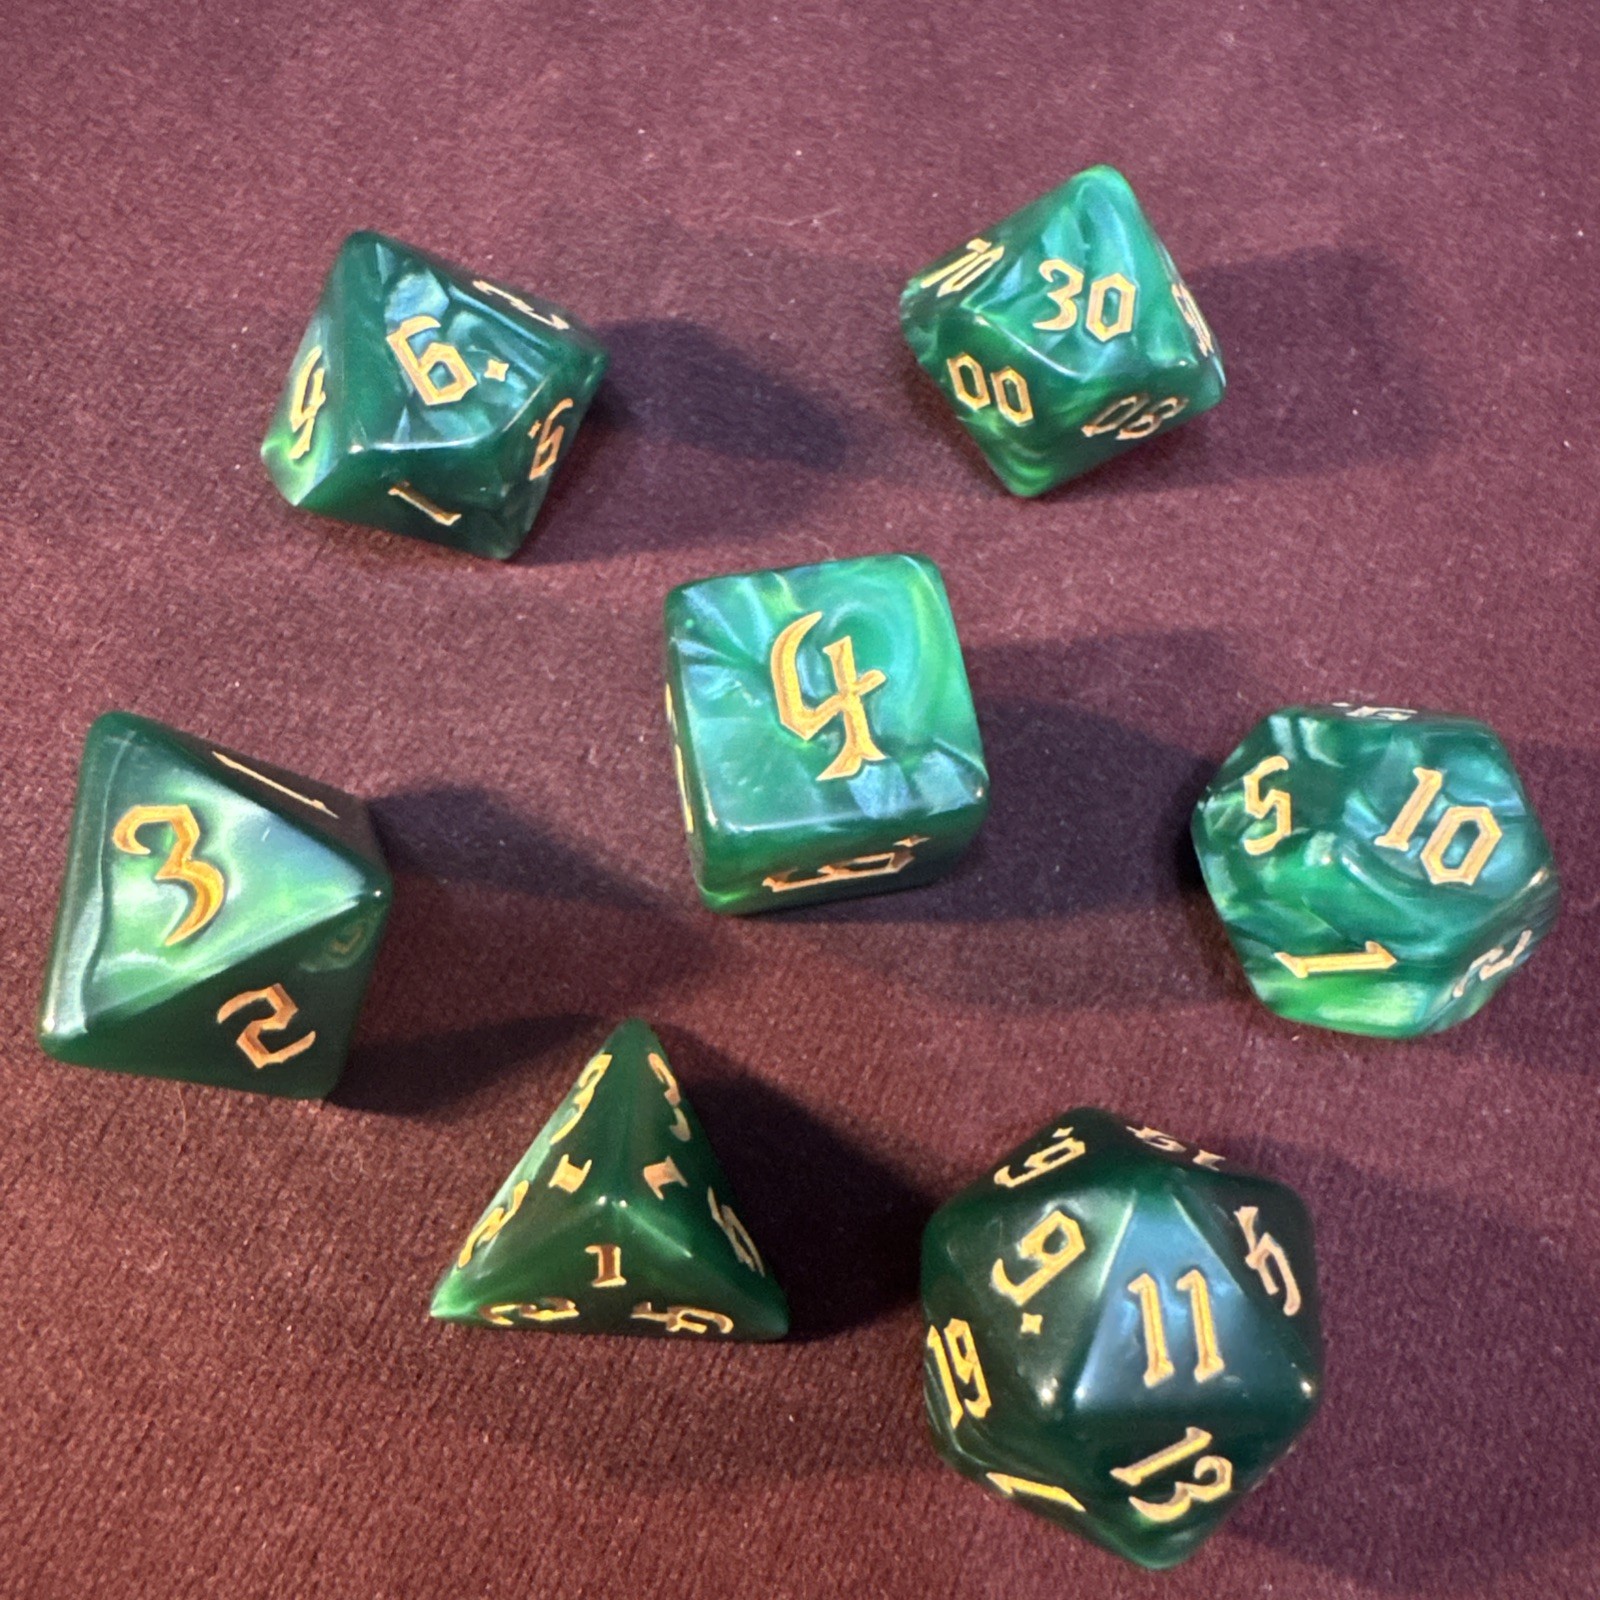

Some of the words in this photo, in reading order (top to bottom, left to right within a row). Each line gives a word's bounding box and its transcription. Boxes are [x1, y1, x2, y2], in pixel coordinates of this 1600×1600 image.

[920, 238, 1004, 298] 10
[1032, 258, 1136, 343] 30
[289, 345, 326, 460] 4
[946, 352, 1034, 427] 00
[388, 482, 462, 526] 1
[770, 610, 887, 782] 4
[1243, 755, 1292, 856] 5
[1374, 766, 1503, 887] 10
[112, 803, 225, 947] 3
[1274, 940, 1397, 979] 1
[216, 982, 317, 1070] 2
[550, 1054, 613, 1145] 3
[648, 1053, 691, 1141] 3
[548, 1154, 592, 1194] 1
[643, 1155, 689, 1200] 1
[457, 1180, 529, 1269] 2
[585, 1244, 628, 1288] 1
[708, 1185, 766, 1278] 4
[1234, 1205, 1301, 1317] 4
[631, 1301, 735, 1334] 4
[1127, 1268, 1226, 1388] 11
[926, 1318, 992, 1430] 19
[1110, 1426, 1233, 1522] 13
